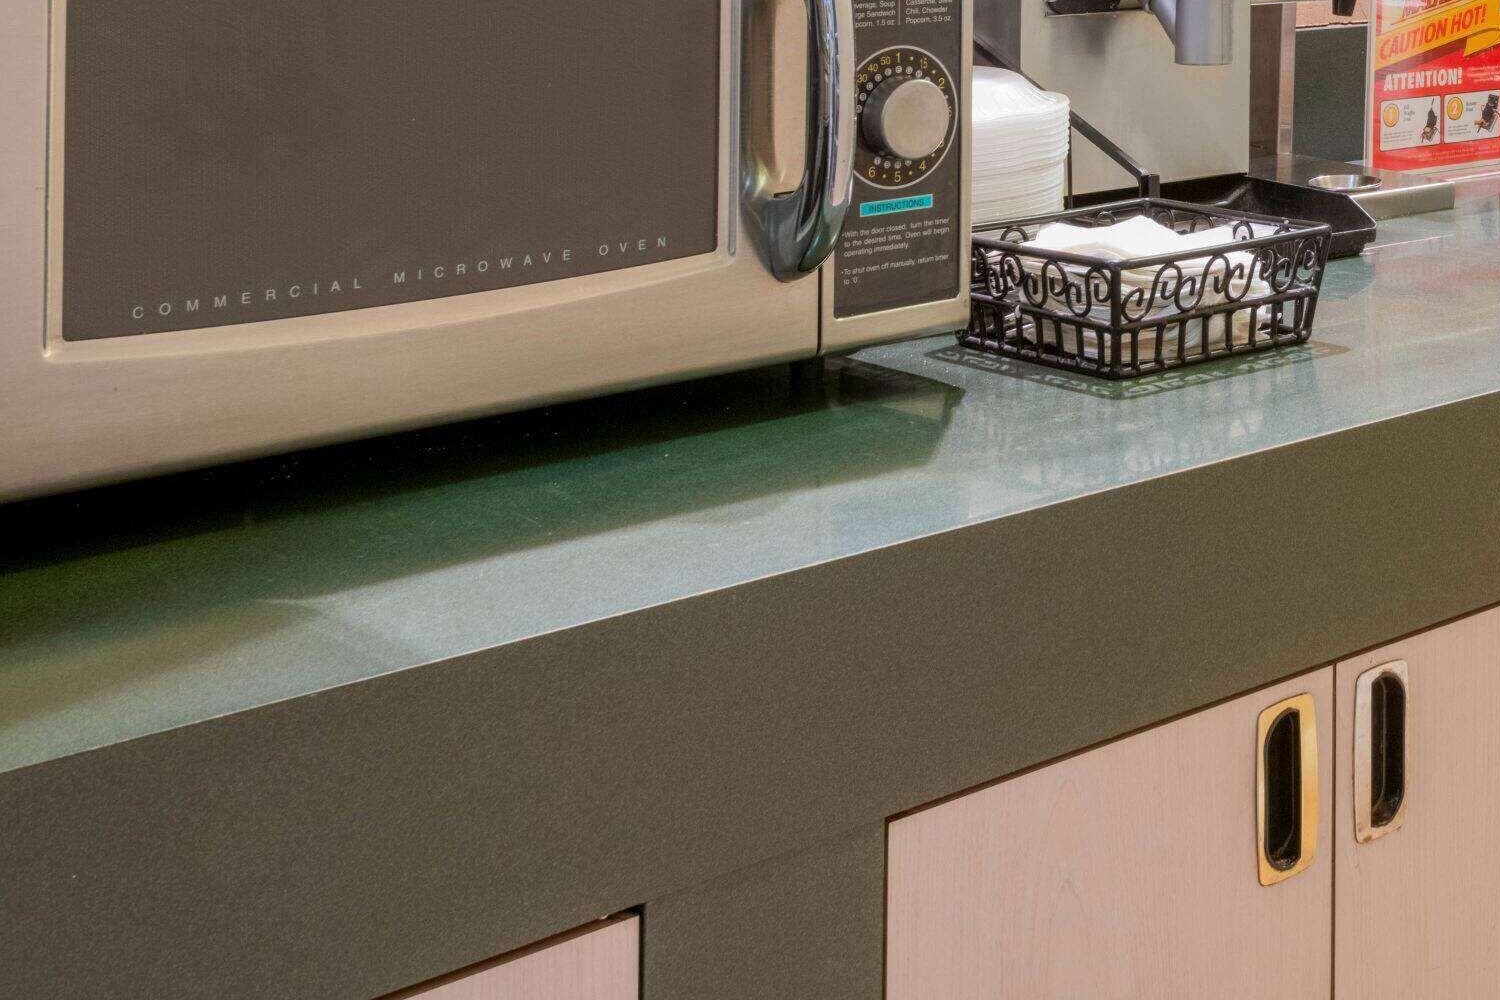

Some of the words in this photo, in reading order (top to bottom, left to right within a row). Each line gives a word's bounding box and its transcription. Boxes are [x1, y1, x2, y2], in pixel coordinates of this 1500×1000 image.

[866, 10, 896, 18] Sandwich
[1379, 21, 1448, 61] CAUTION
[1451, 3, 1488, 33] HOT!
[880, 56, 891, 65] 50
[867, 63, 879, 72] 40
[857, 74, 868, 83] 30
[938, 78, 945, 89] 2
[1383, 66, 1463, 92] ATTENTION!
[919, 160, 926, 171] 4
[868, 166, 876, 178] 6
[894, 170, 901, 183] 5
[869, 199, 924, 214] INSTRUCTIONS
[132, 277, 362, 320] COMMERCIAL
[393, 249, 573, 285] MICROWAVE
[599, 236, 667, 256] OVEN
